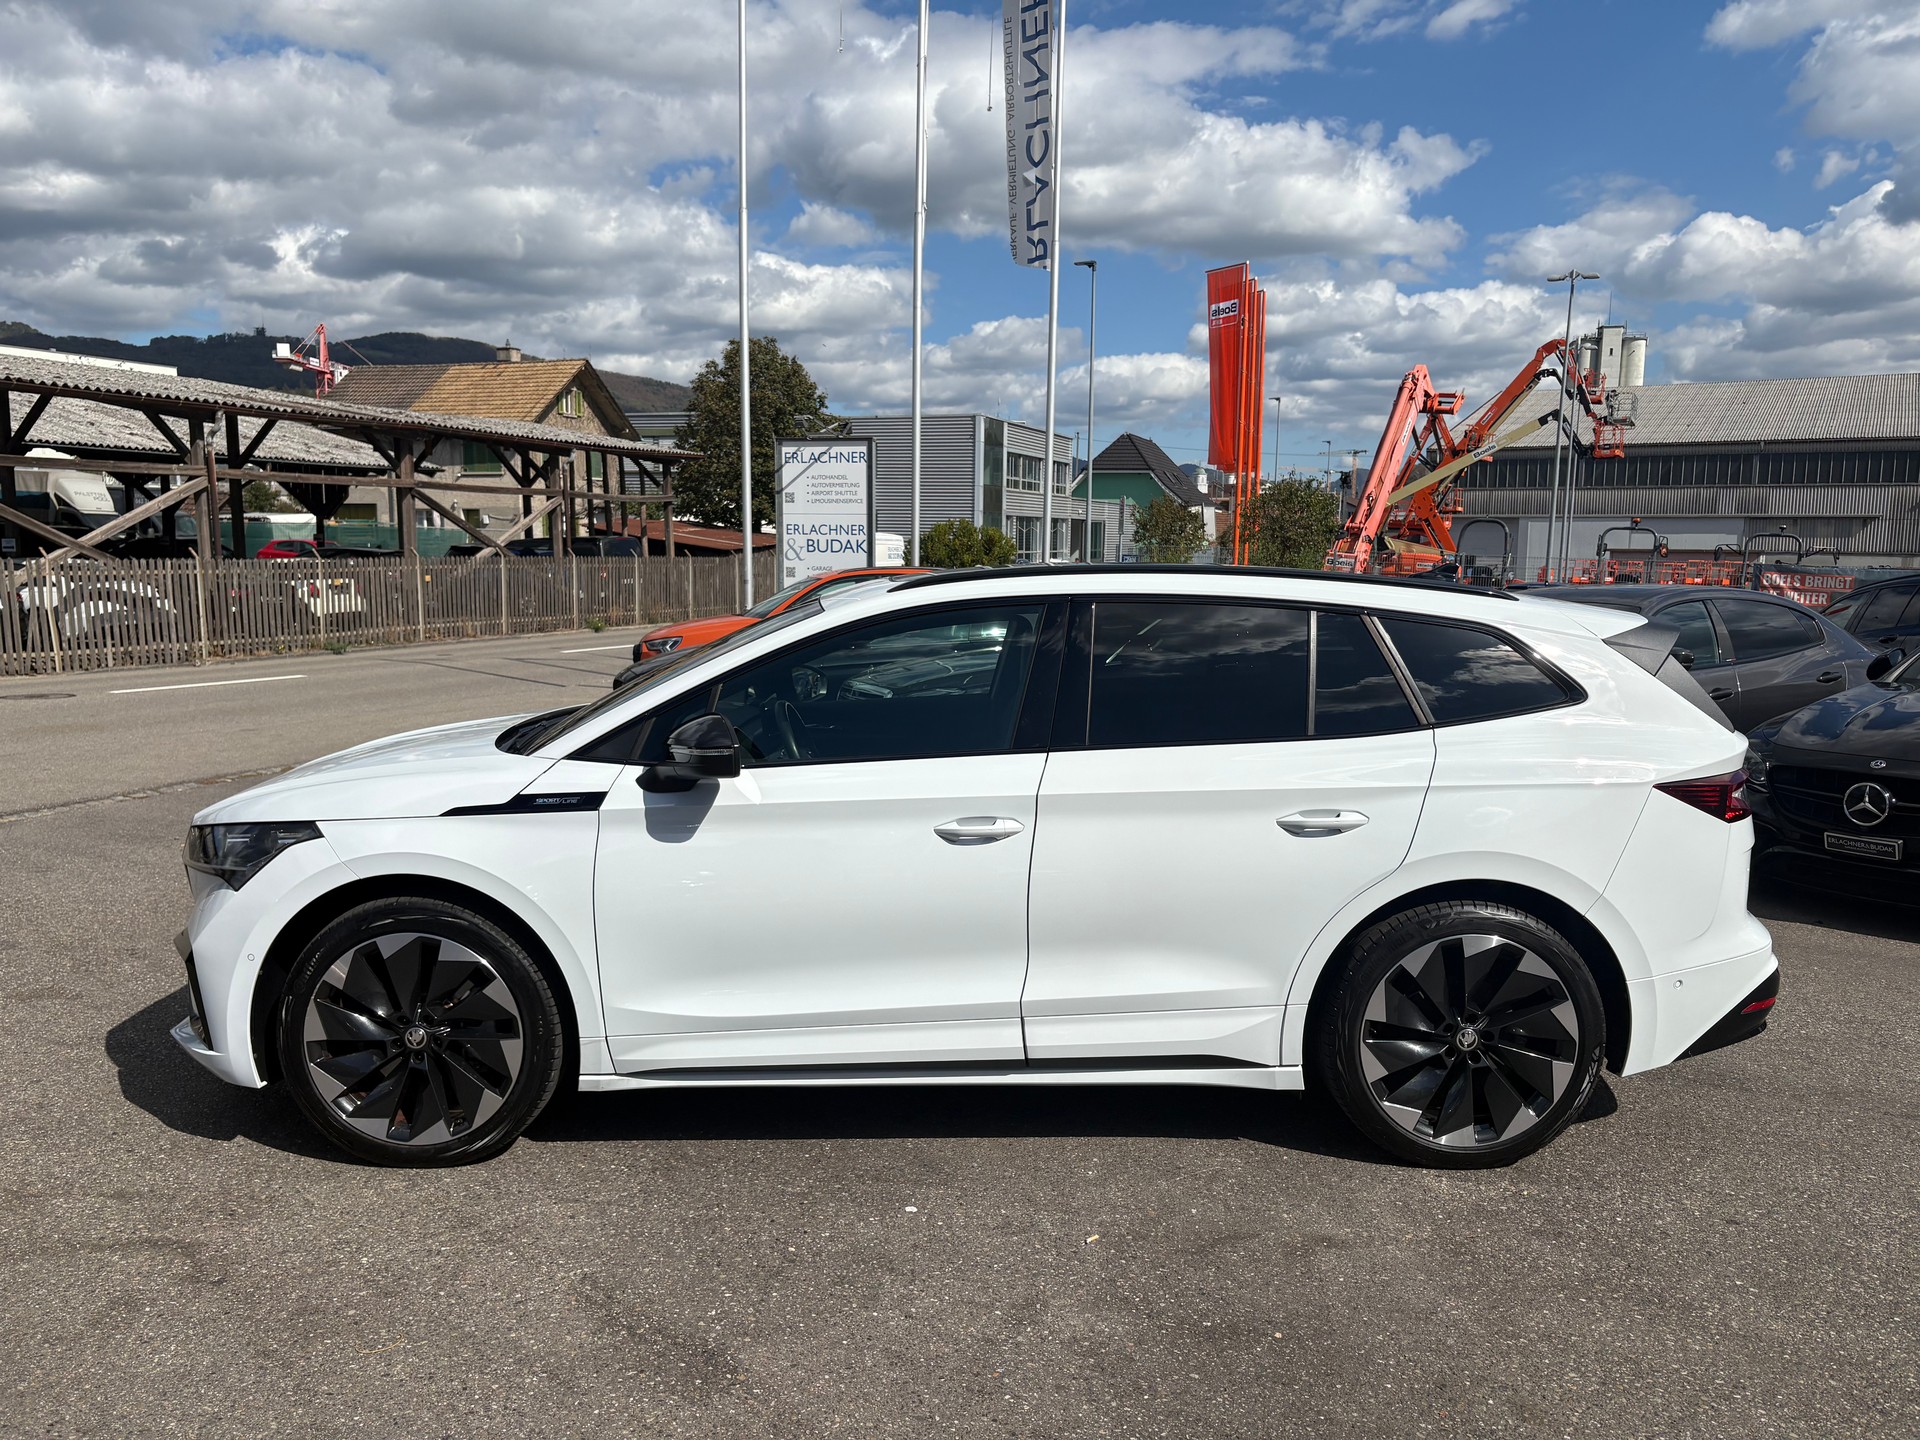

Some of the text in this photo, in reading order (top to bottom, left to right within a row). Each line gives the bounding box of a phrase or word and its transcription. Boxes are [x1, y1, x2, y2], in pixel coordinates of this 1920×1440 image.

[784, 451, 867, 464] ERLACHNER
[1473, 443, 1497, 459] Boels
[786, 523, 866, 536] ERLACHNER
[785, 537, 867, 561] & BUDAK
[1763, 573, 1853, 589] BOELS BRINGT
[1784, 590, 1828, 604] WEITER
